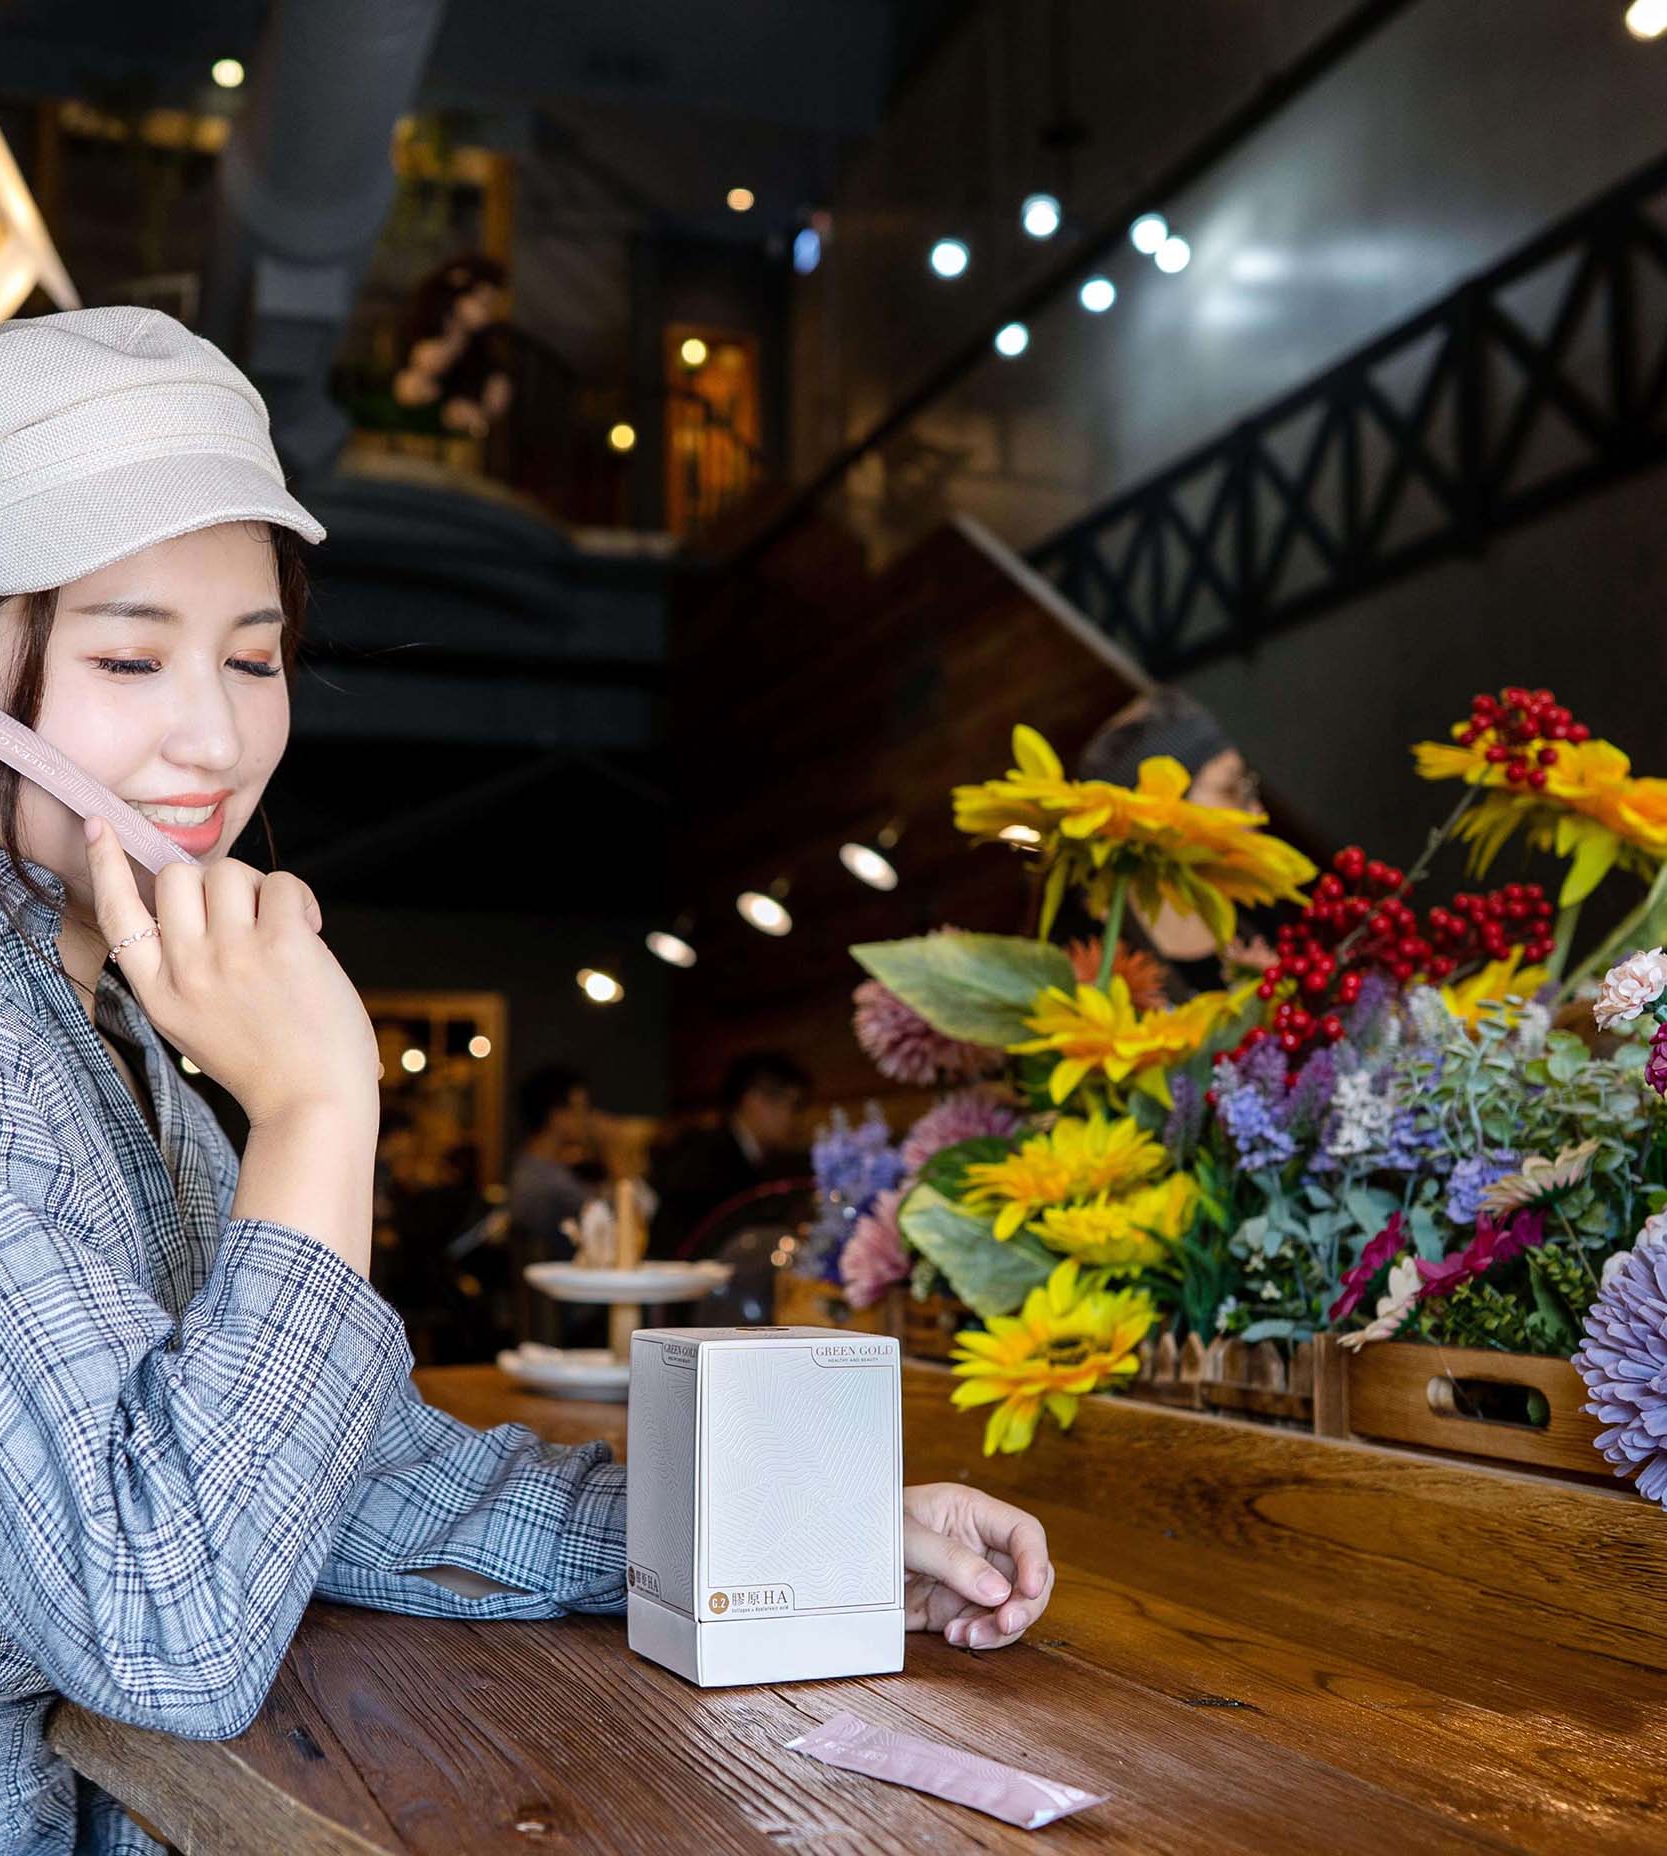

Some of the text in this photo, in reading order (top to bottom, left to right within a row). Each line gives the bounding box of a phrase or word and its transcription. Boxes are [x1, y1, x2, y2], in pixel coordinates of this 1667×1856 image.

[11, 743, 56, 776] GREEN
[815, 1345, 894, 1357] GREEN GOLD
